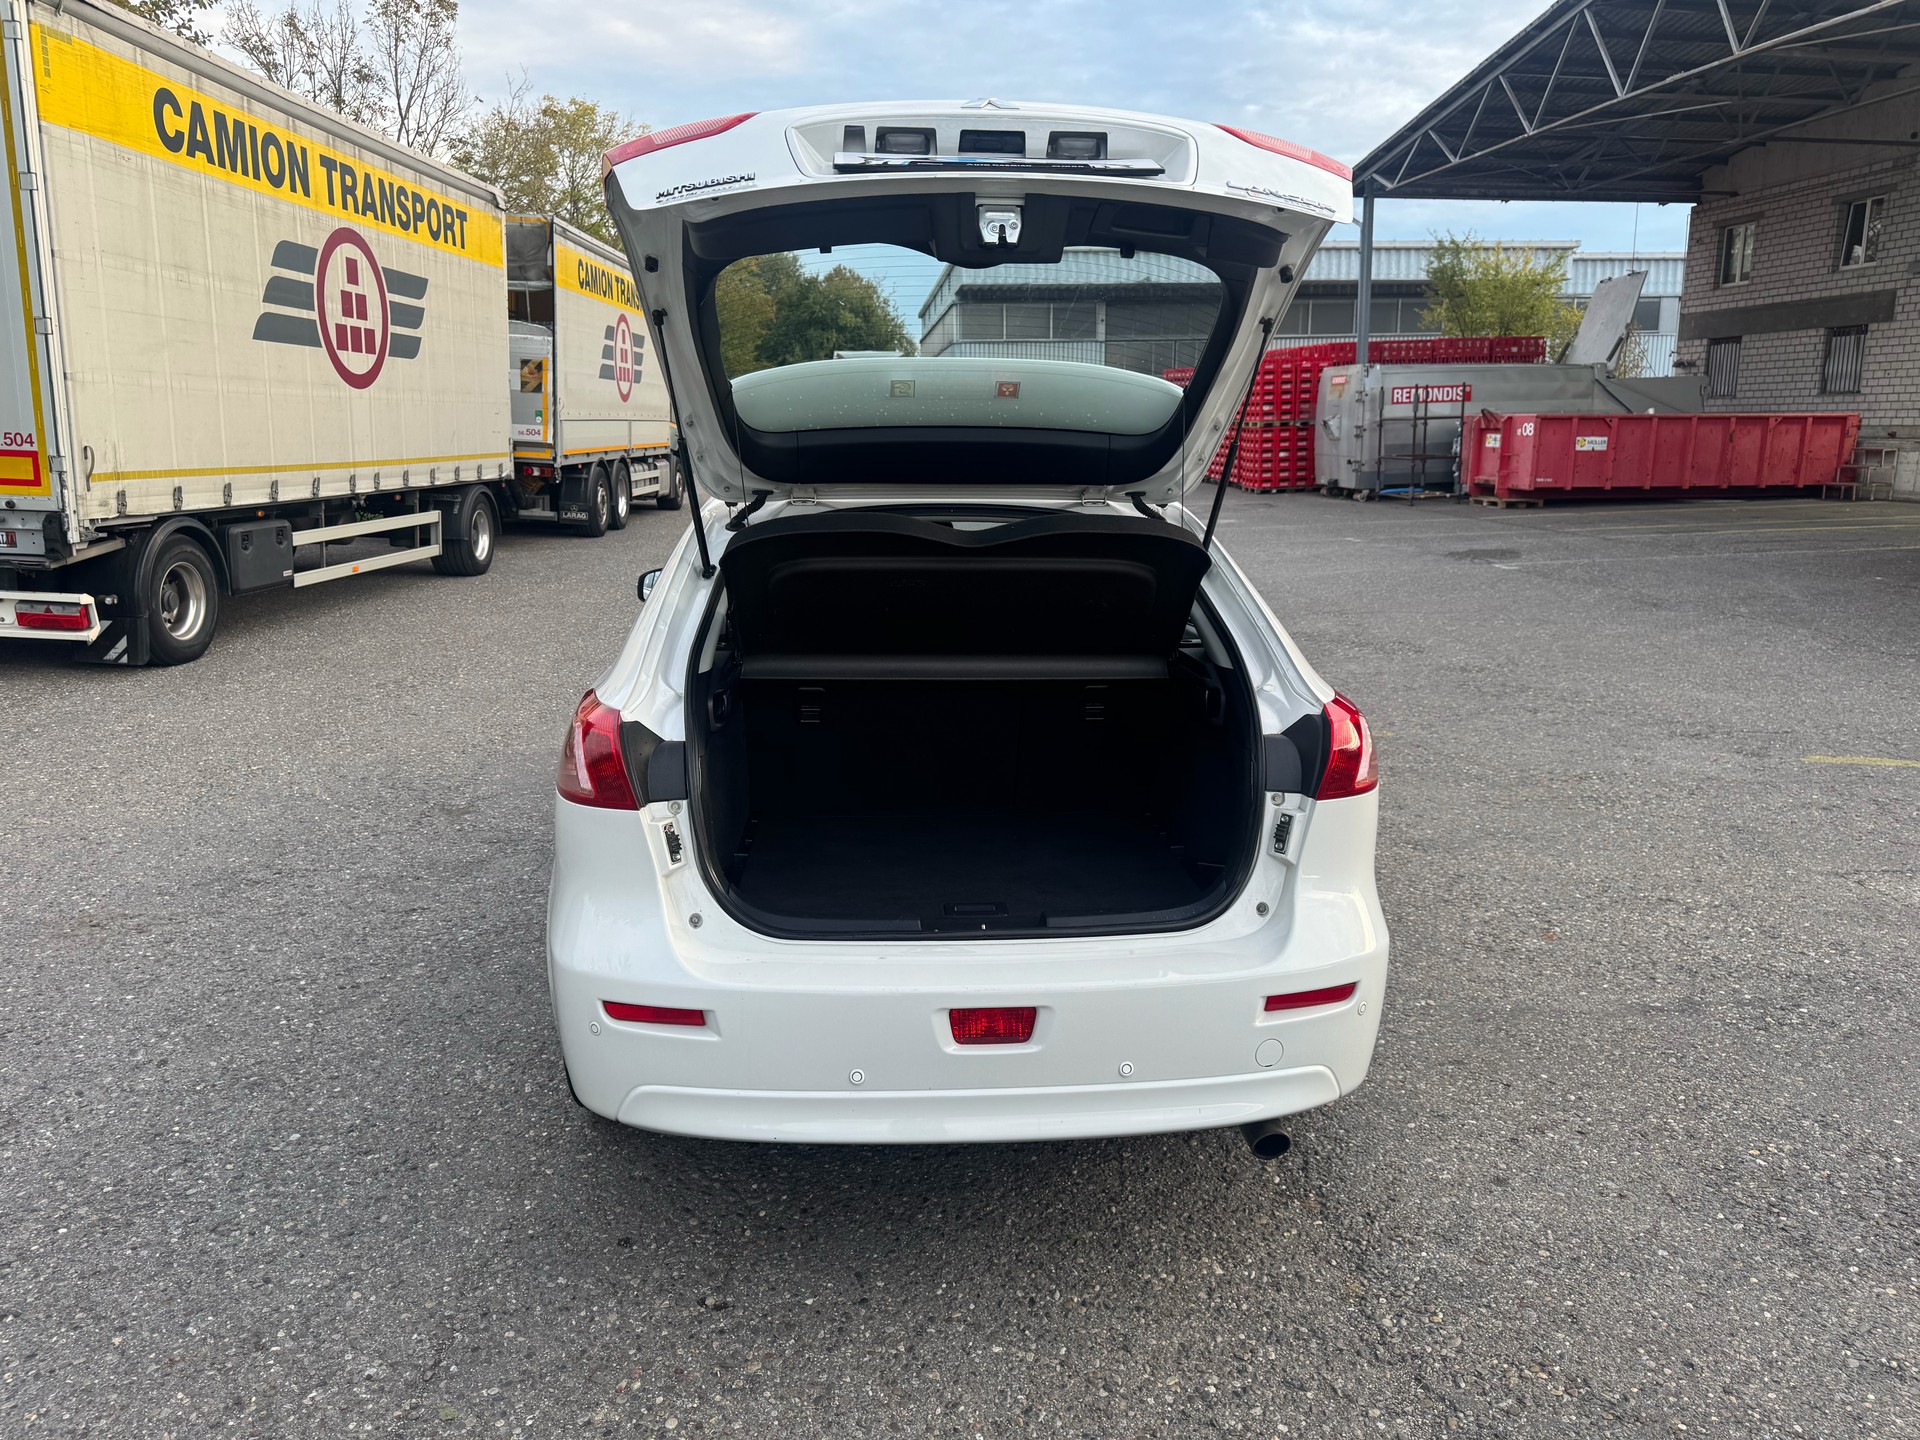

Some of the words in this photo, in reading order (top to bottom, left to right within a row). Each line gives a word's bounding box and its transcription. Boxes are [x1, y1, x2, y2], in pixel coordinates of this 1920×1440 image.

[153, 88, 310, 198] CAMION
[319, 154, 467, 250] TRANSPORT
[656, 172, 756, 199] MITSUBISHI
[577, 258, 613, 300] CAMION
[1393, 386, 1464, 403] REMONDIS
[1522, 422, 1534, 436] 08
